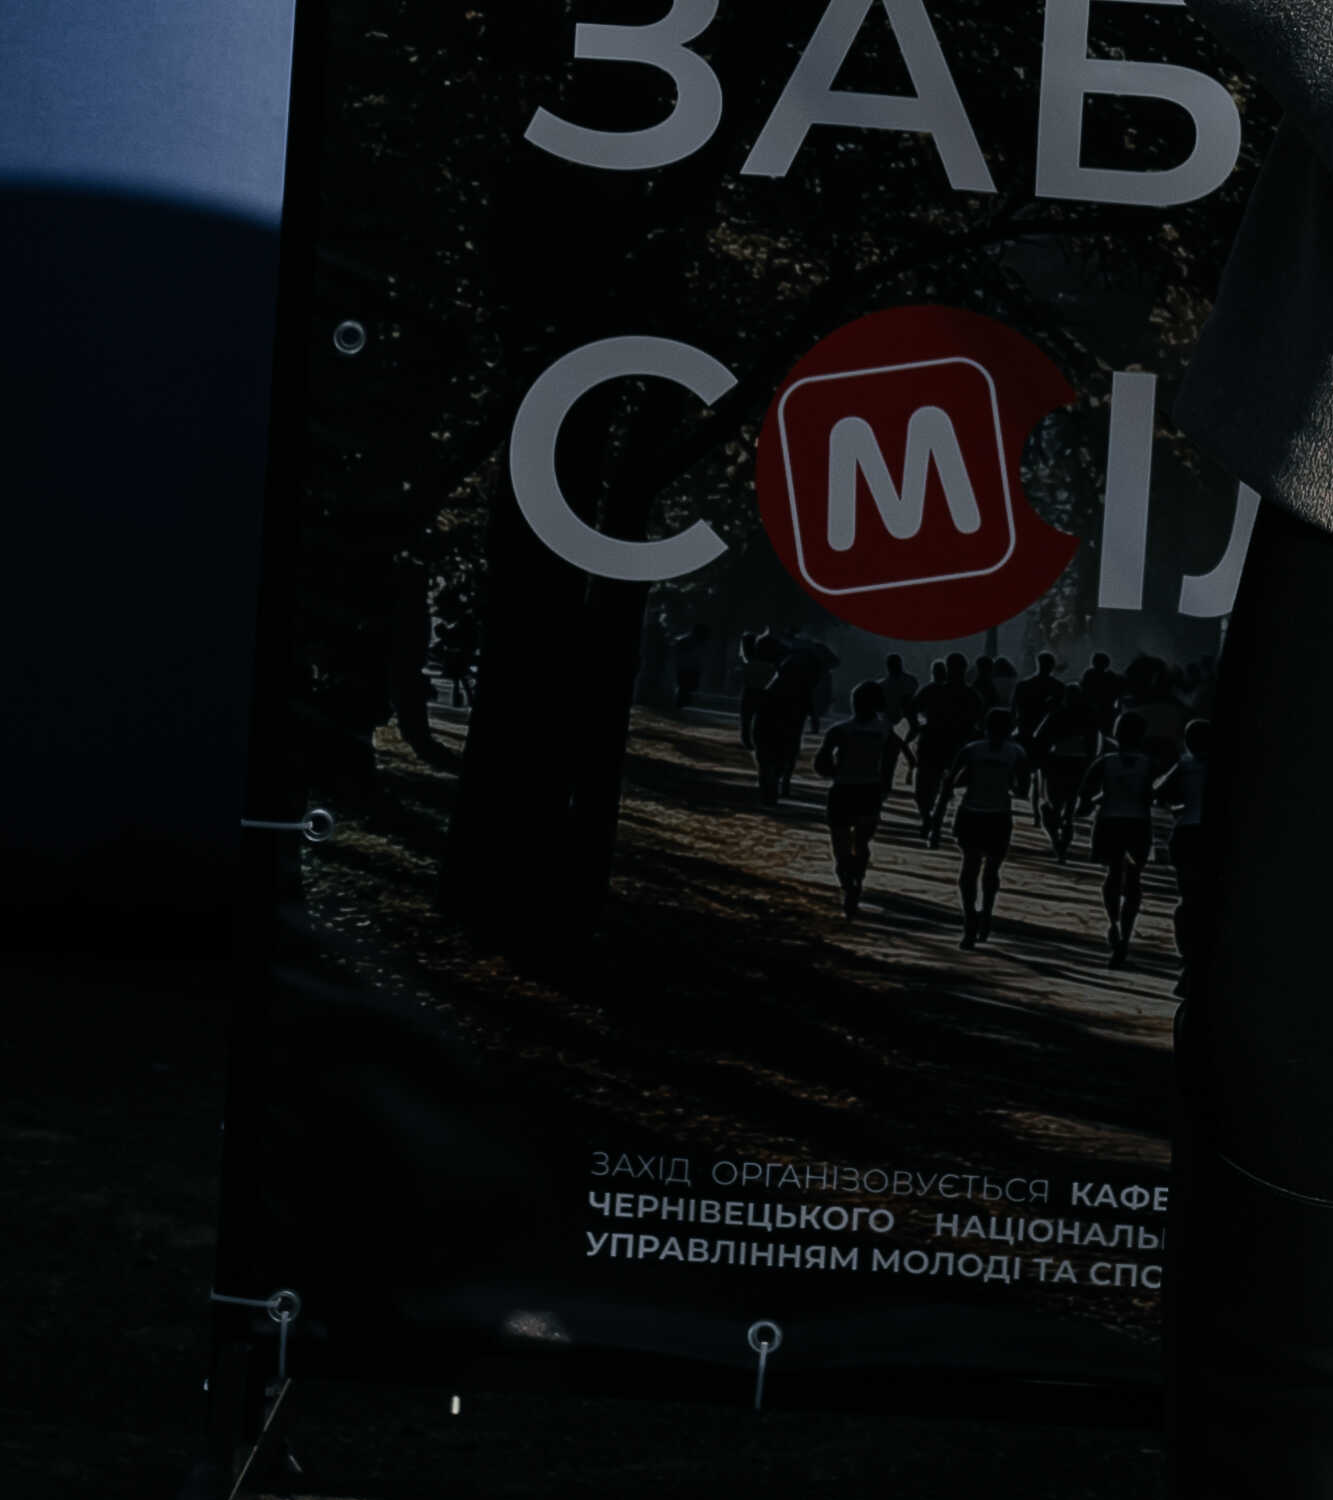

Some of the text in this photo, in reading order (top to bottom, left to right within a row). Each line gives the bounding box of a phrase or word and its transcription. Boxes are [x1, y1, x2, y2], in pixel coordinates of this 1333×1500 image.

[590, 1151, 692, 1187] ЗАХІД
[711, 1160, 1050, 1204] ОРГАНІЗОВУЄТЬСЯ
[1072, 1182, 1169, 1211] КАФЕ
[589, 1191, 895, 1233] ЧЕРНІВЕЦЬКОГО
[936, 1213, 1166, 1251] НАЦІОНАЛЬ
[584, 1230, 860, 1272] УПРАВЛІННЯМ
[872, 1247, 1022, 1284] МОЛОДІ
[1034, 1258, 1077, 1285] ТА
